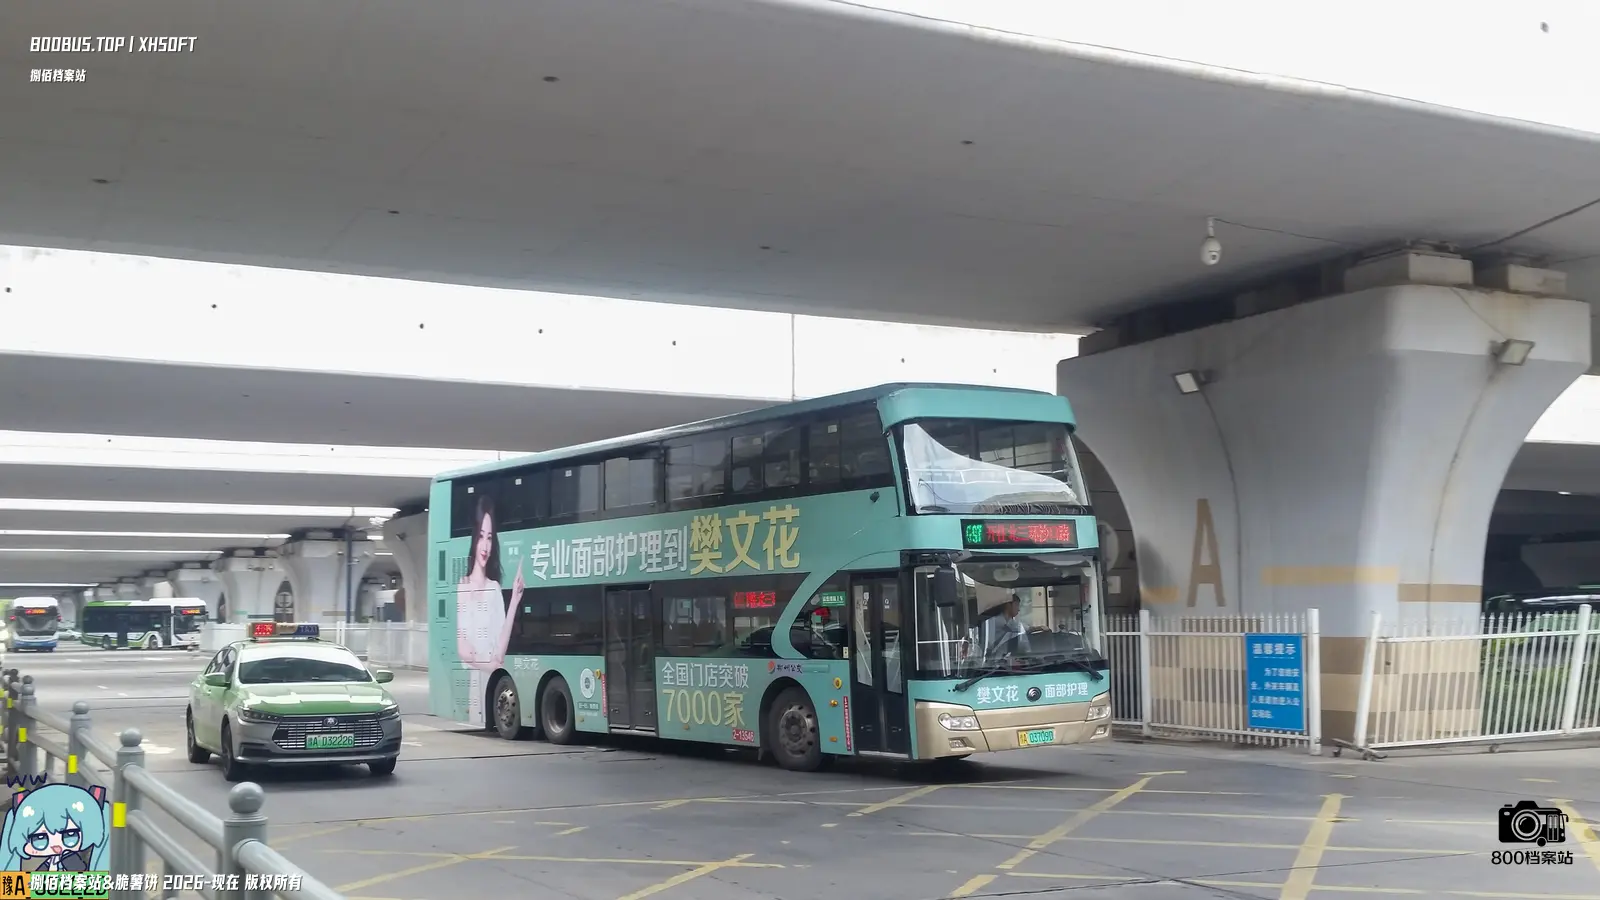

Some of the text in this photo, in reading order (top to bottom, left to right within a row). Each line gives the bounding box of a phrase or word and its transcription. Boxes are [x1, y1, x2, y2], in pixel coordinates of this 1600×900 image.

[1187, 498, 1227, 608] A
[299, 625, 318, 634] TAXI
[661, 660, 750, 689] 全国门店突破
[976, 685, 1020, 704] 樊文花
[1044, 682, 1089, 699] 面部护理
[662, 690, 746, 728] 7000家
